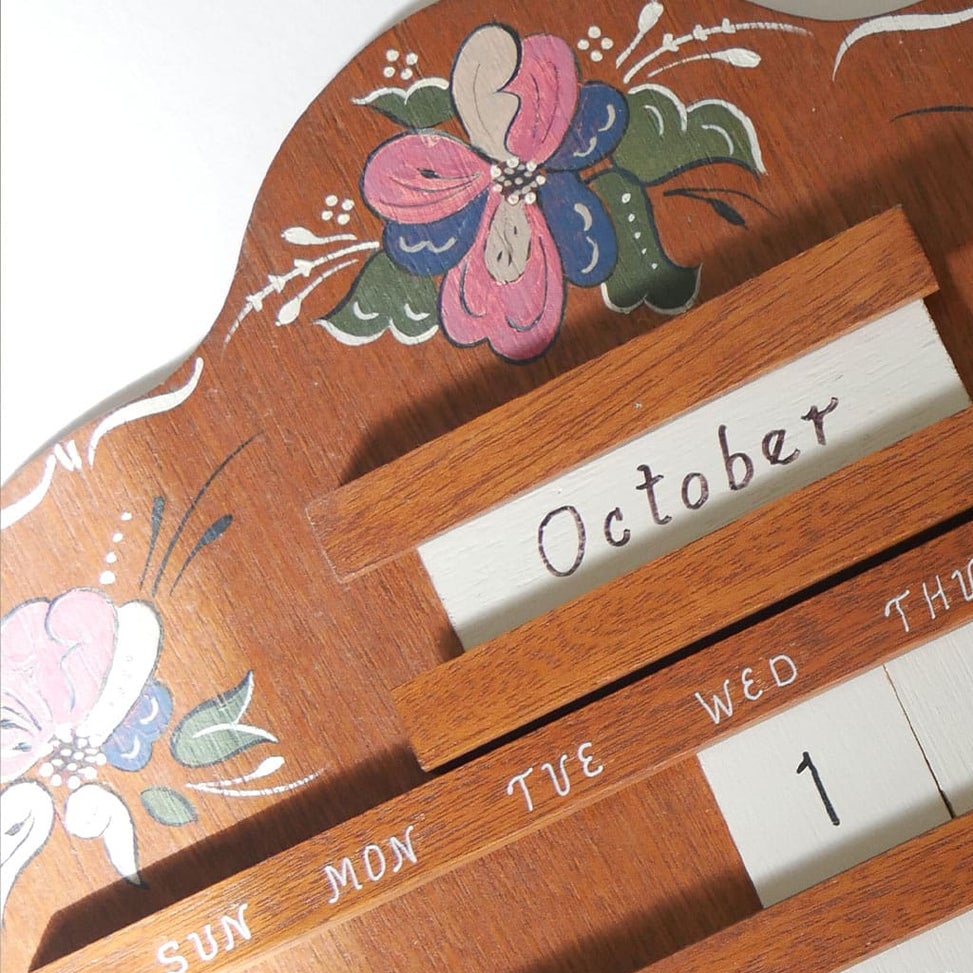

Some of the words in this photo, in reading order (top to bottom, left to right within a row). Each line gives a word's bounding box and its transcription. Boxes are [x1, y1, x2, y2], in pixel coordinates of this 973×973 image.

[538, 397, 839, 578] October
[323, 825, 418, 903] MON
[506, 742, 604, 812] TUE
[695, 654, 798, 725] WED
[796, 751, 840, 827] 1
